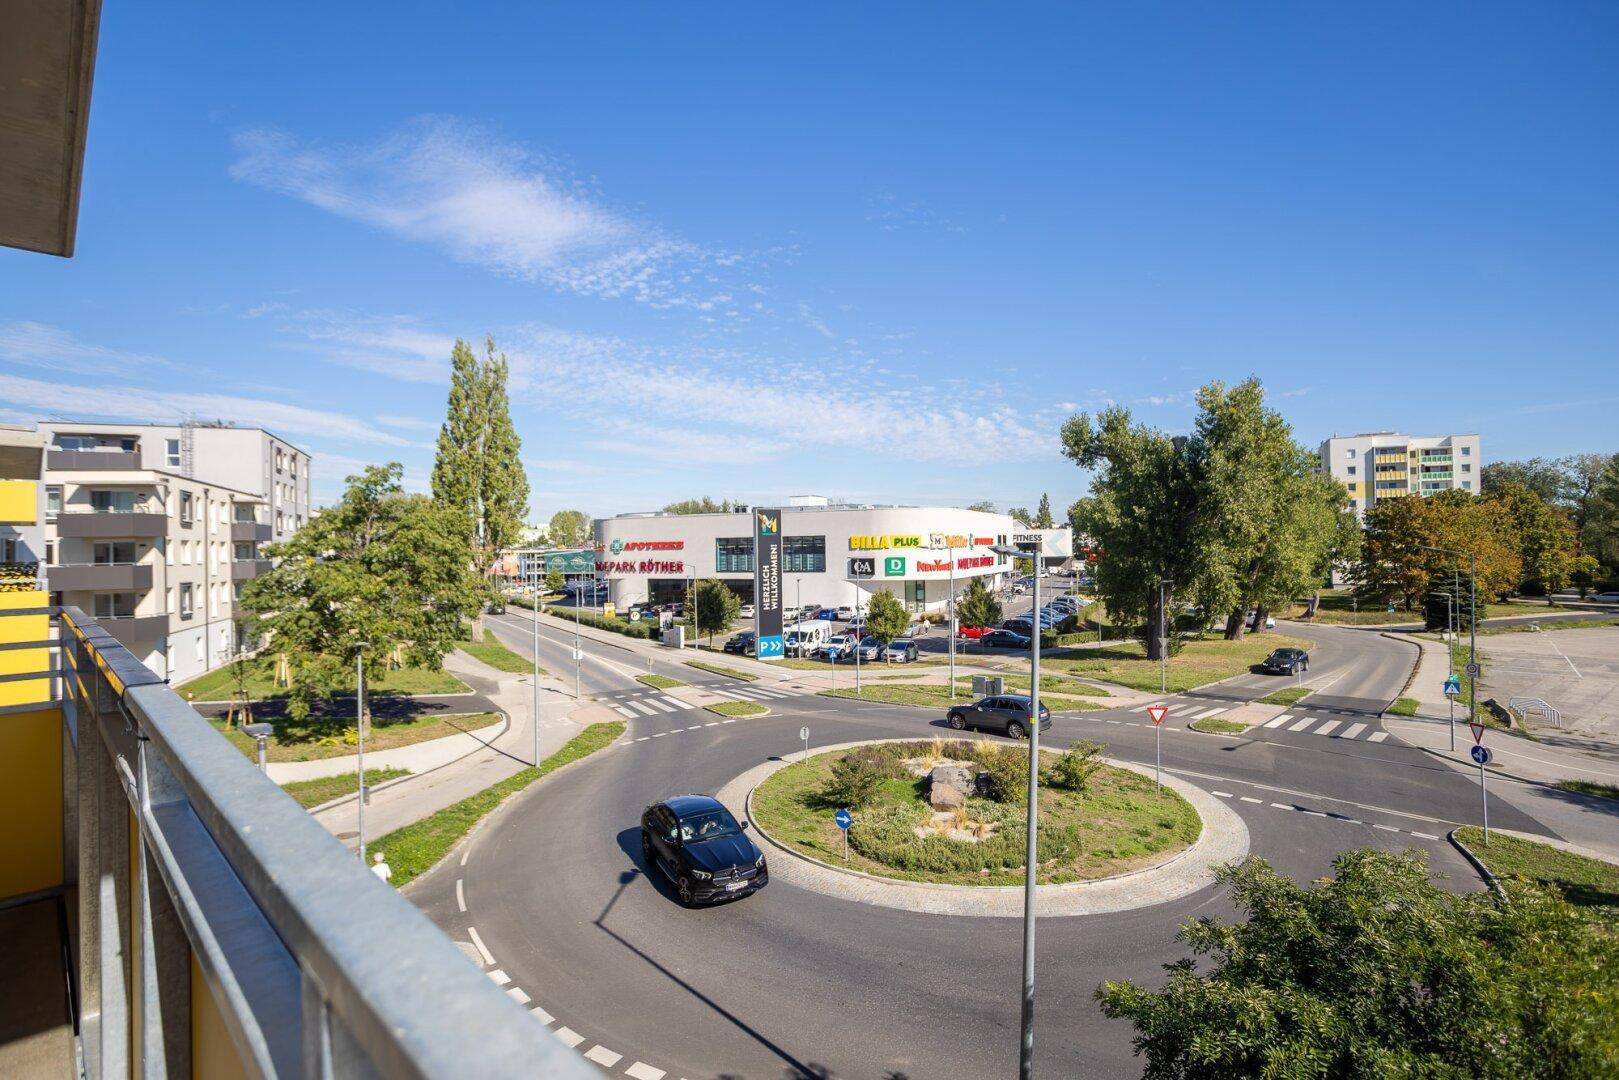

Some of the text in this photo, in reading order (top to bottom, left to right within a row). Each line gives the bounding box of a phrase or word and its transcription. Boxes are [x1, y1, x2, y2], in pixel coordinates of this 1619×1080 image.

[848, 535, 919, 551] BILLA PLUS
[1013, 534, 1042, 542] FITNESS
[639, 558, 684, 573] RÖTHER
[853, 561, 872, 573] C&A
[890, 560, 902, 570] D
[760, 641, 769, 652] P
